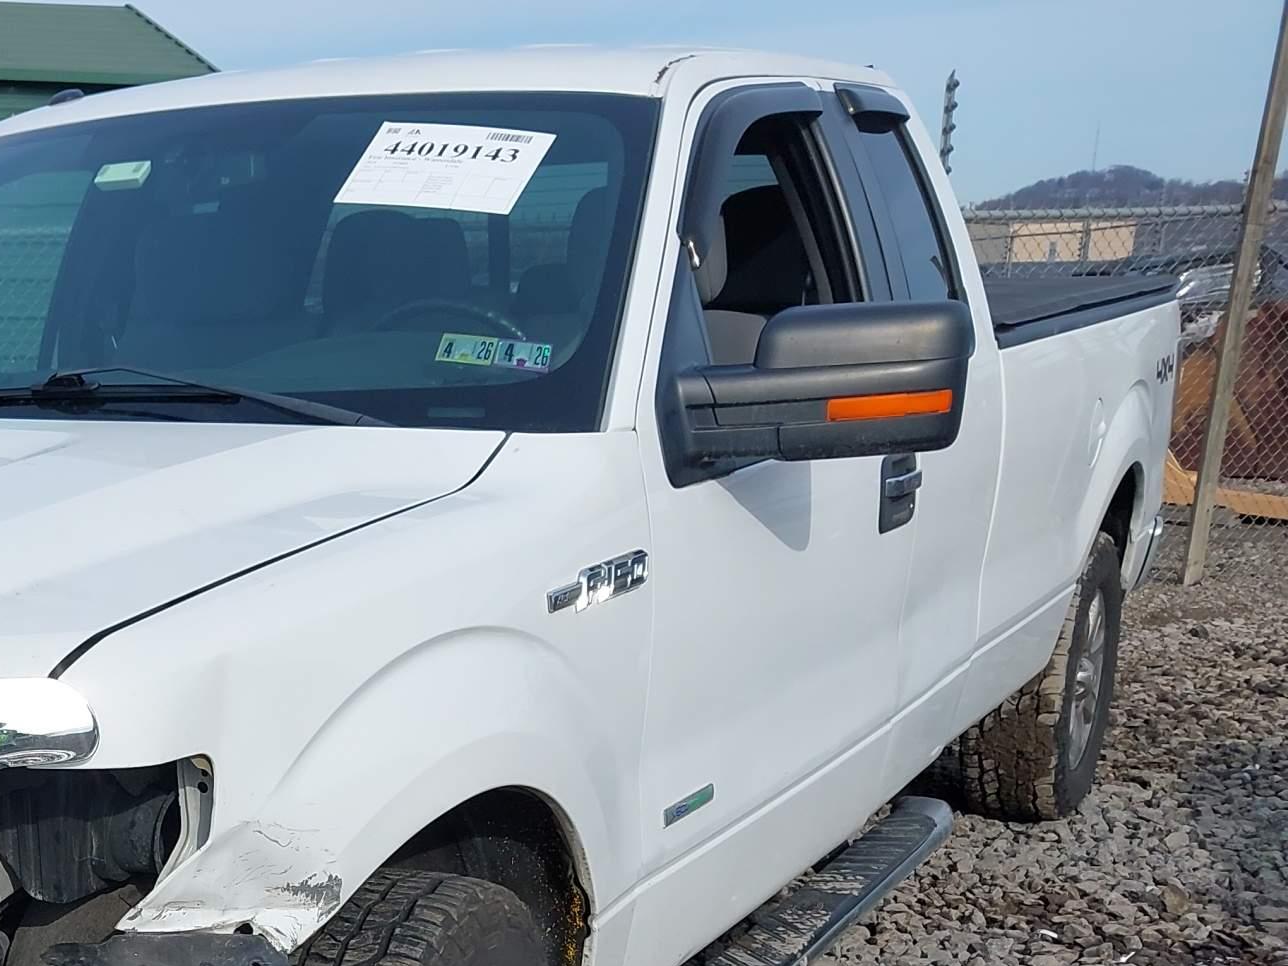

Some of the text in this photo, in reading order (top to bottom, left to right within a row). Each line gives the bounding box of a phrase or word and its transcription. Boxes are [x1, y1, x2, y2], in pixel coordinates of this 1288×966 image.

[383, 140, 520, 163] 44019143
[443, 341, 494, 361] 4 26
[504, 343, 550, 366] 4 26
